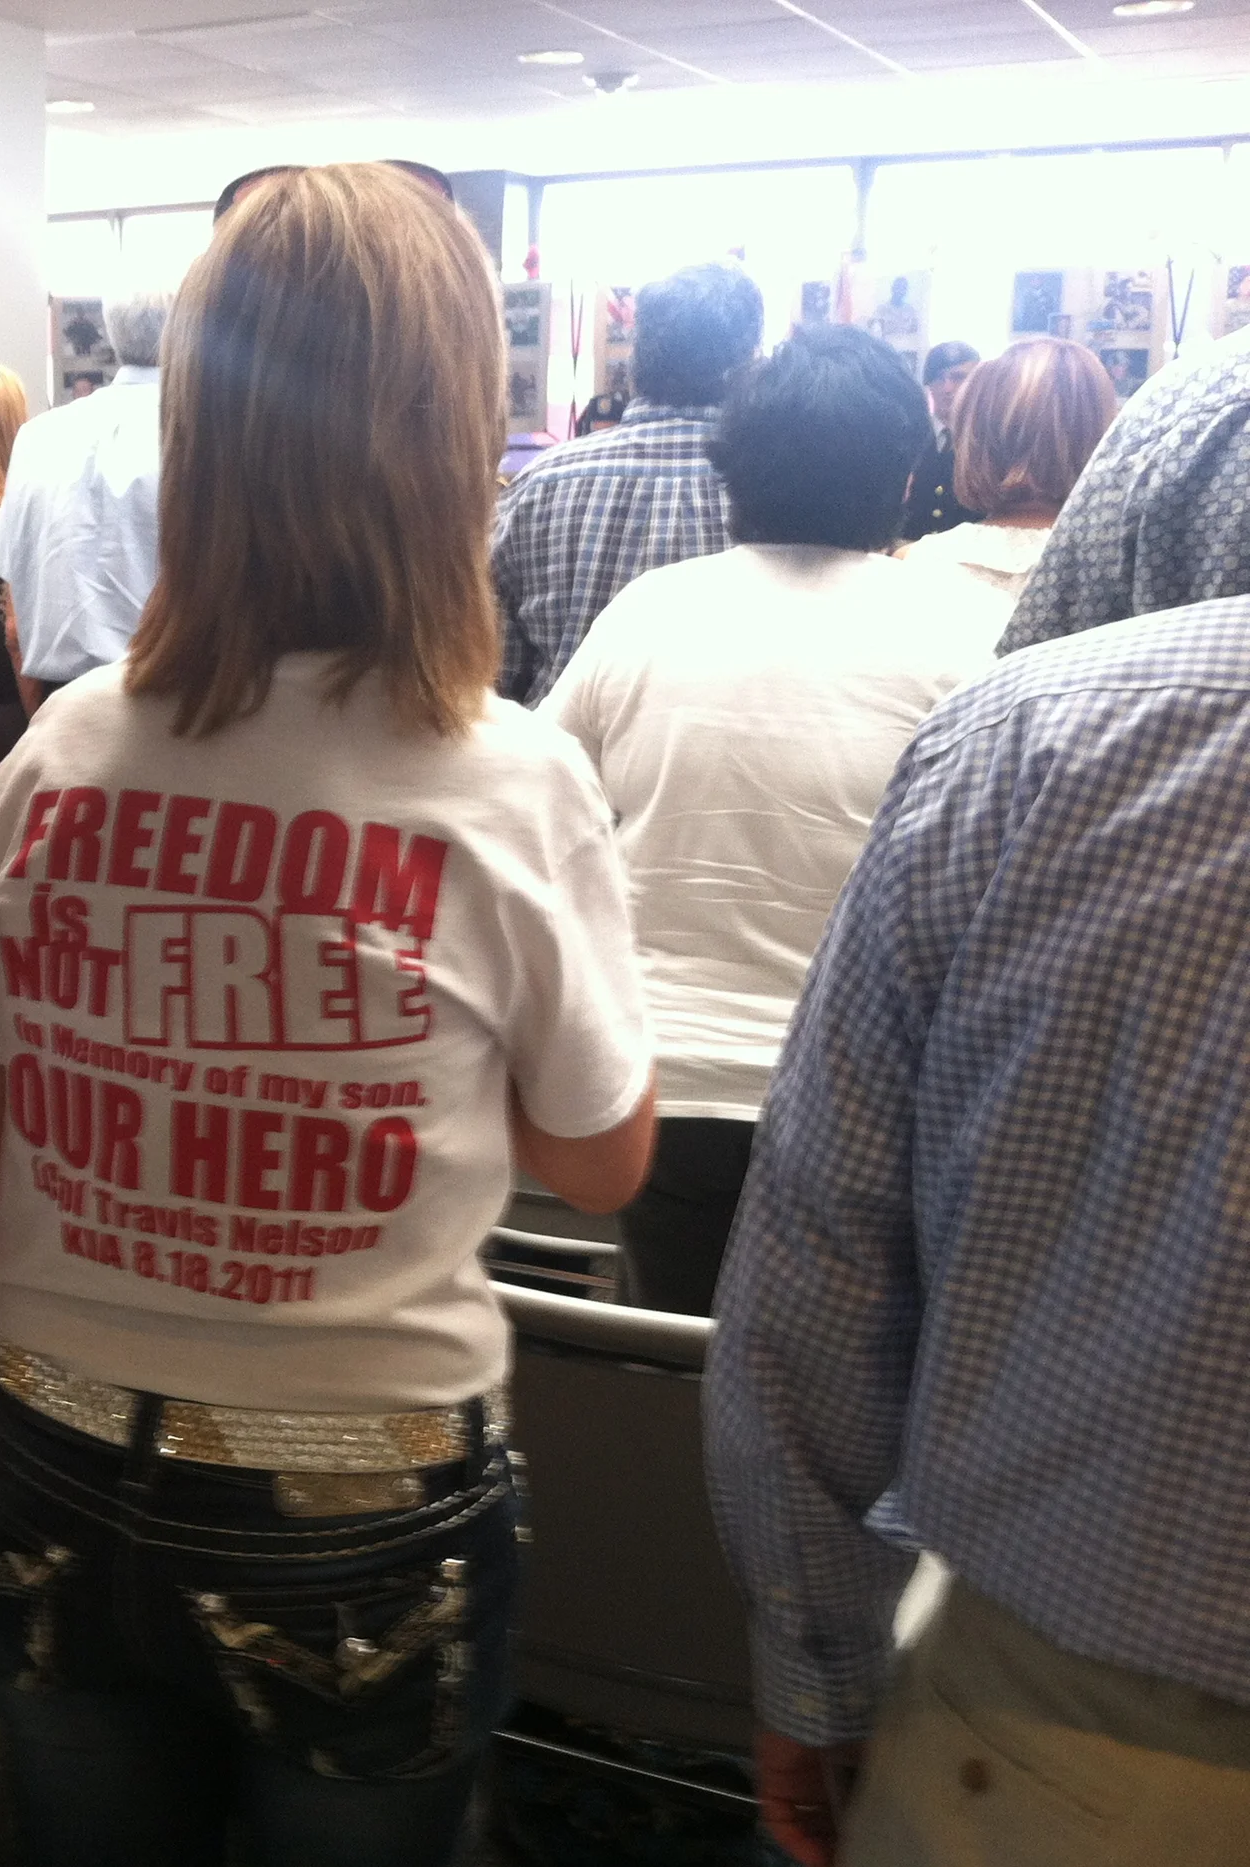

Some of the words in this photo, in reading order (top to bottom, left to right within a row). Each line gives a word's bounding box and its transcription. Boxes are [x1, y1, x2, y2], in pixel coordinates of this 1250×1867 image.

[7, 785, 449, 939] FREEDOM
[30, 883, 89, 947] is
[0, 934, 123, 1018] NOT
[123, 903, 432, 1051] FREE
[52, 1022, 196, 1092] Memory
[205, 1065, 250, 1098] of
[259, 1073, 330, 1110] my
[8, 1052, 144, 1191] OUR
[169, 1099, 418, 1213] HERO
[61, 1222, 126, 1270] KIA
[133, 1240, 315, 1304] 8.18.2011
[94, 1187, 219, 1248] Travis
[231, 1214, 382, 1257] Nelson
